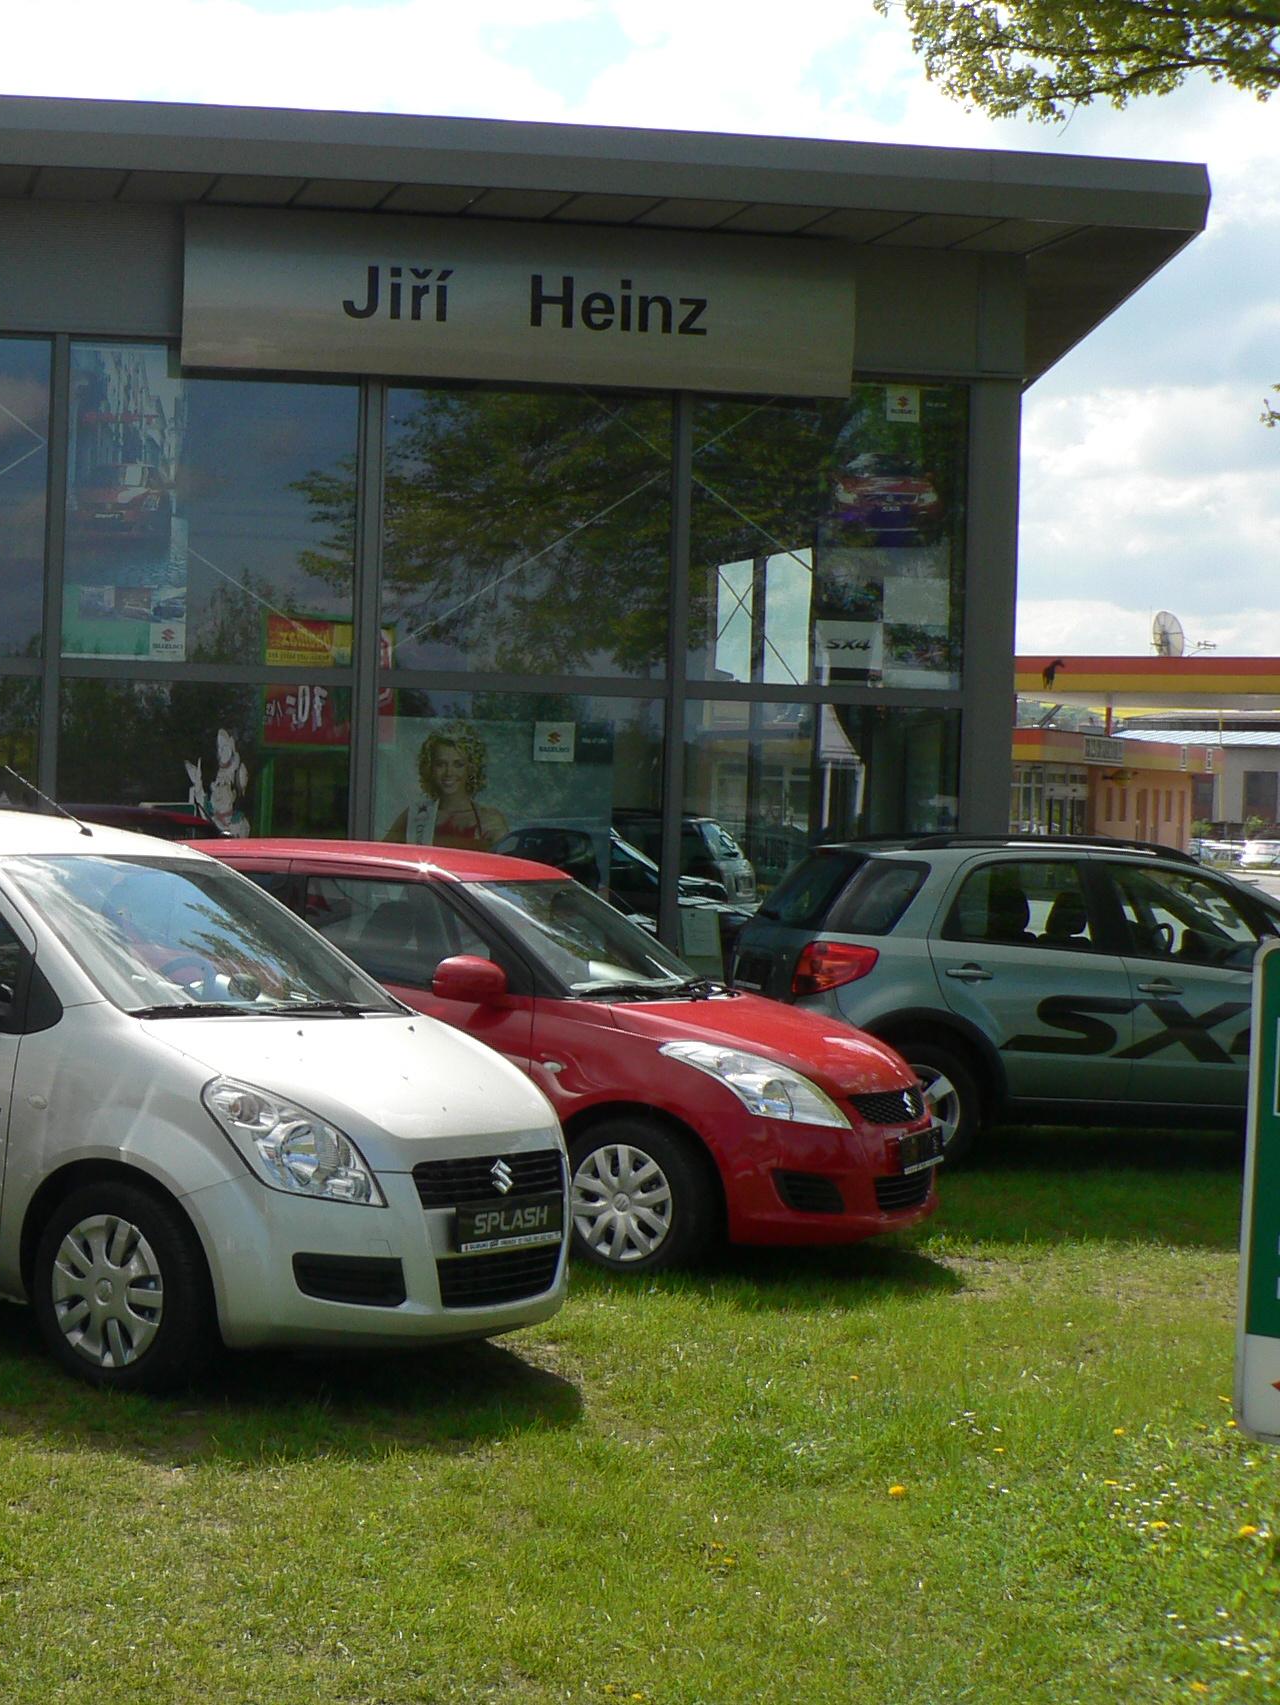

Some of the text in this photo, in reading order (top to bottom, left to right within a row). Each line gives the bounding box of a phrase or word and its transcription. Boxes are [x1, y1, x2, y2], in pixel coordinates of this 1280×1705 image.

[342, 265, 708, 336] Jiří Heinz
[826, 639, 871, 650] SX4
[999, 995, 1252, 1063] SX
[473, 1205, 549, 1235] SPLASH
